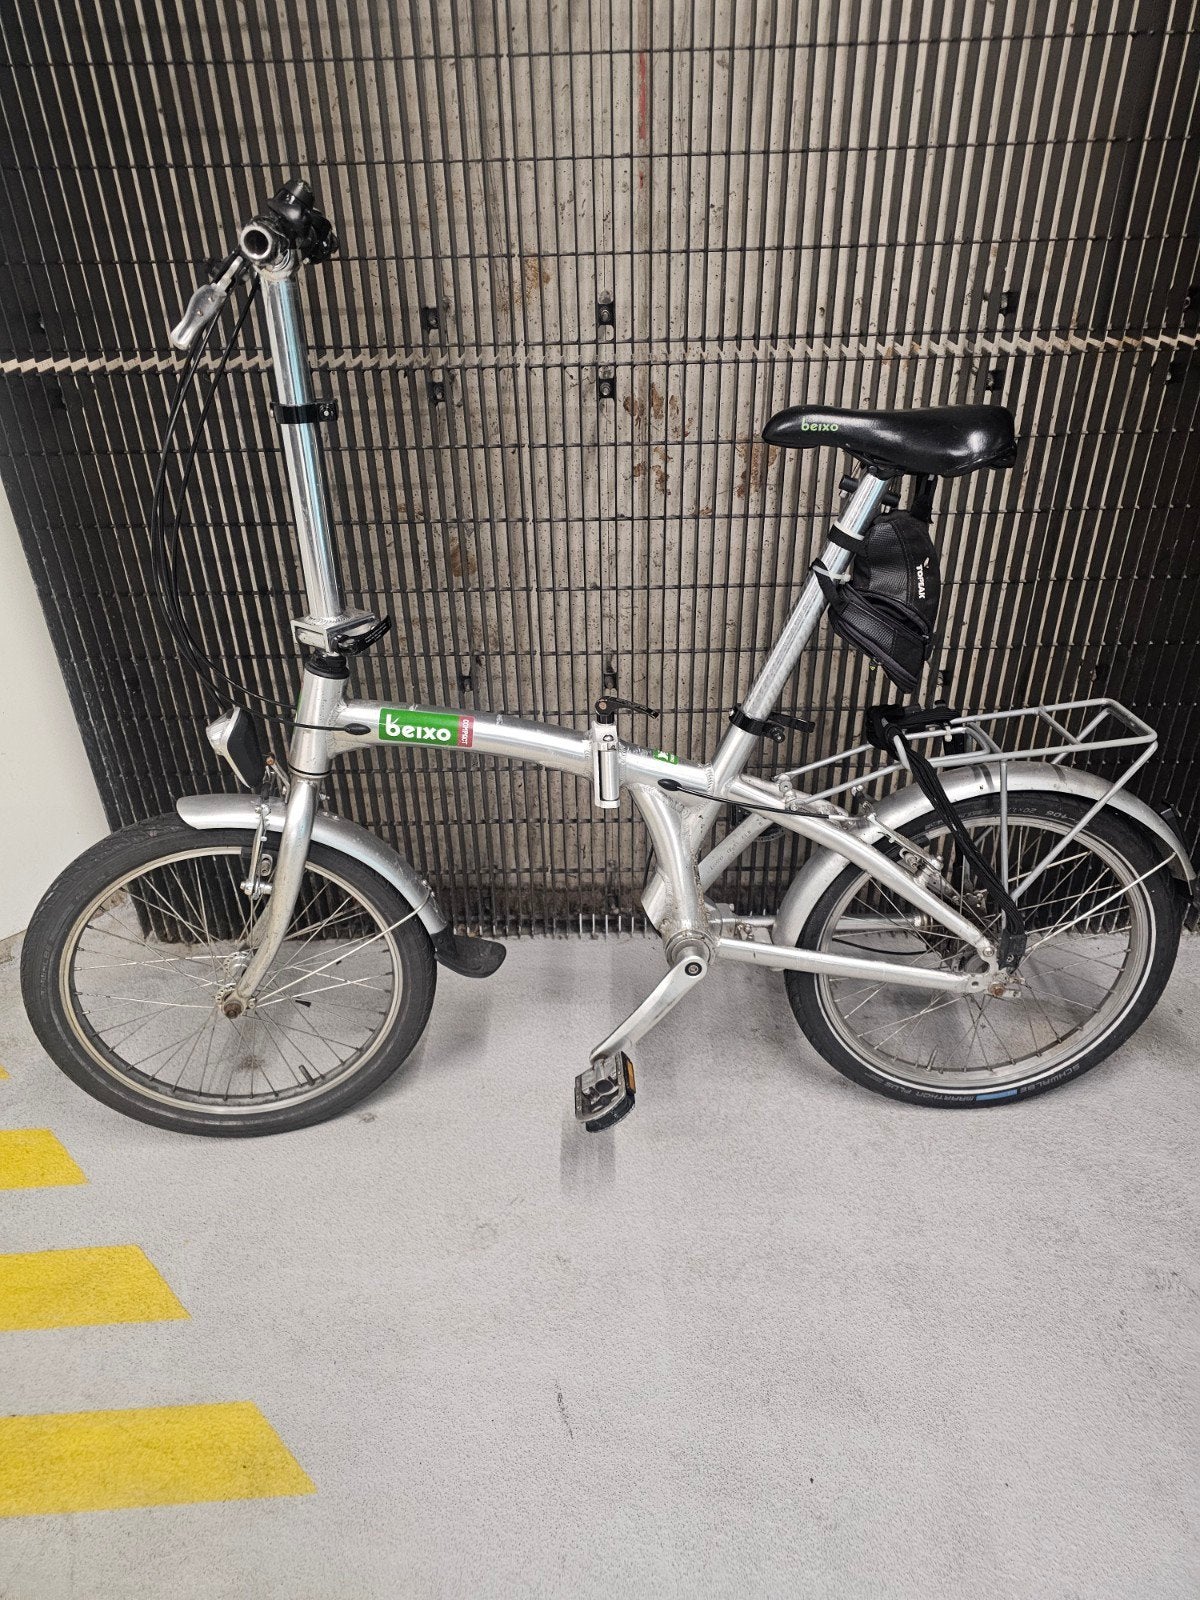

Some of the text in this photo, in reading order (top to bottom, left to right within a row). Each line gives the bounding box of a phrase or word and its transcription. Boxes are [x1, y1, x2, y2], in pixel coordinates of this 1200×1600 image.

[800, 418, 839, 432] beixo
[915, 564, 926, 599] TOPEAK
[385, 713, 452, 742] beixo
[1019, 1063, 1081, 1094] SCHWALBE
